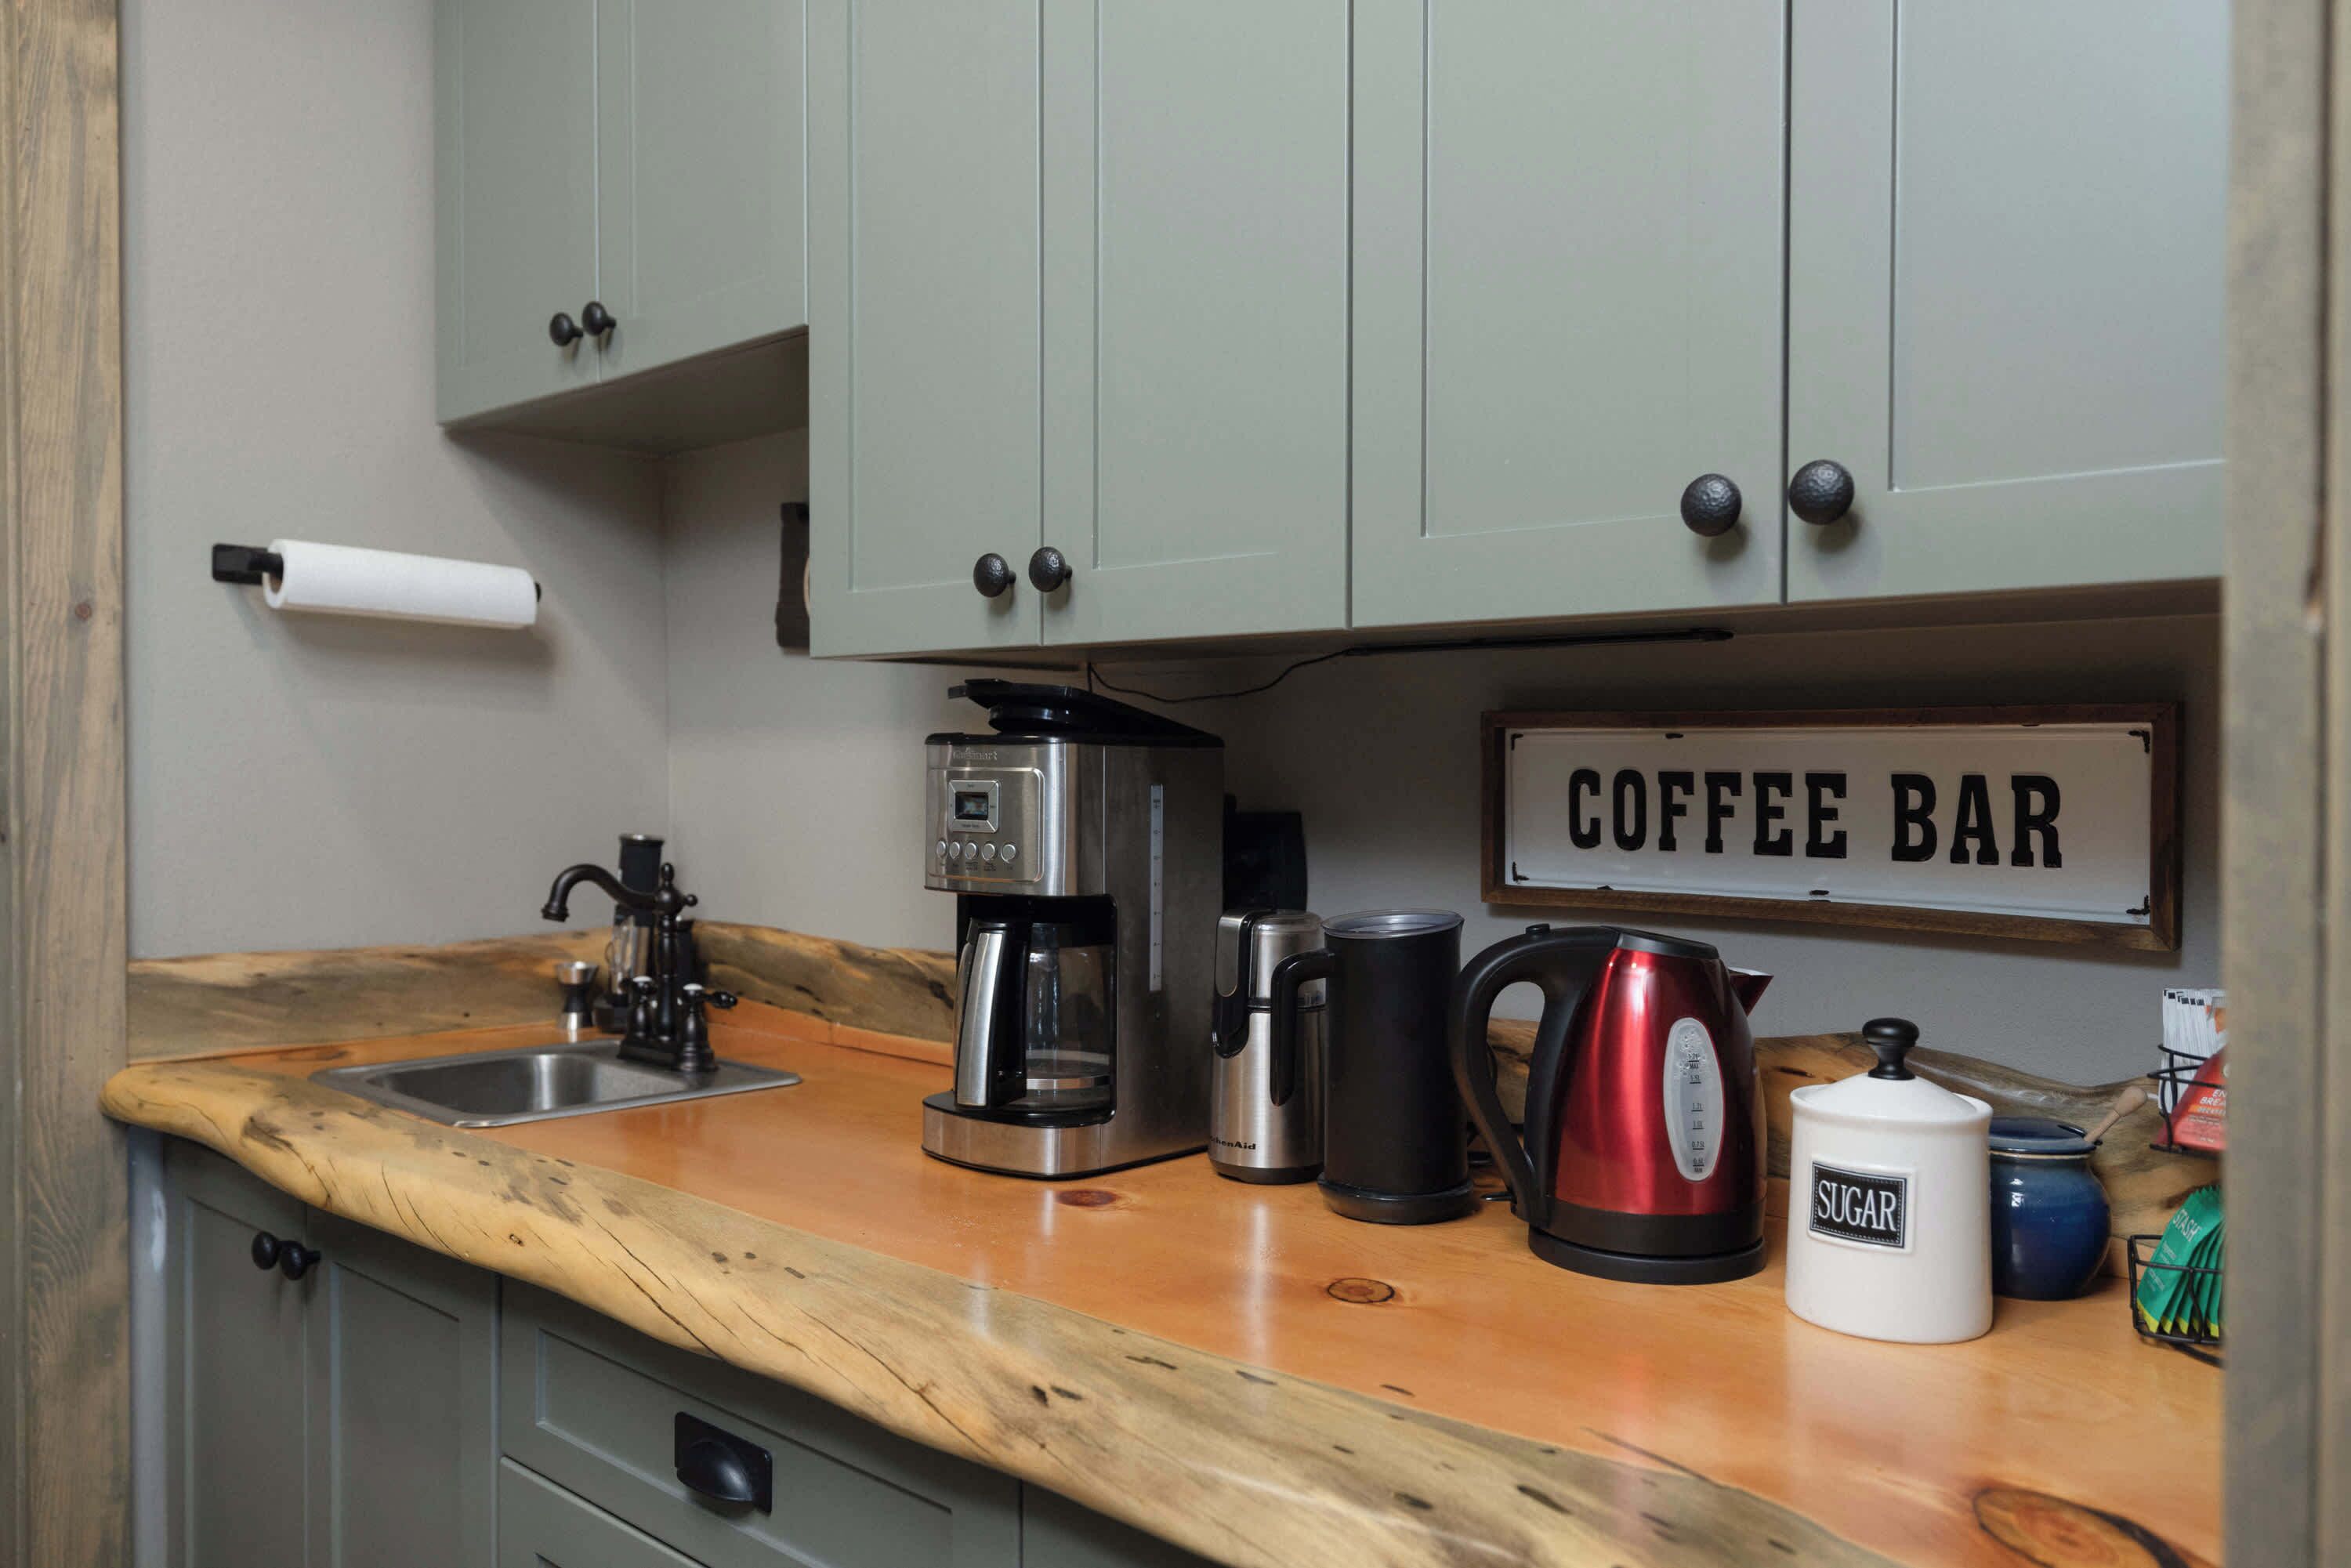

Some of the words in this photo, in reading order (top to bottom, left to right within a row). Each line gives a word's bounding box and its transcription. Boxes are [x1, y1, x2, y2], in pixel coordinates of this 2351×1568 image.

[1569, 769, 1847, 859] COFFEE
[1890, 773, 2063, 868] BAR
[1817, 1179, 1897, 1232] SUGAR
[2172, 1208, 2201, 1242] STASH
